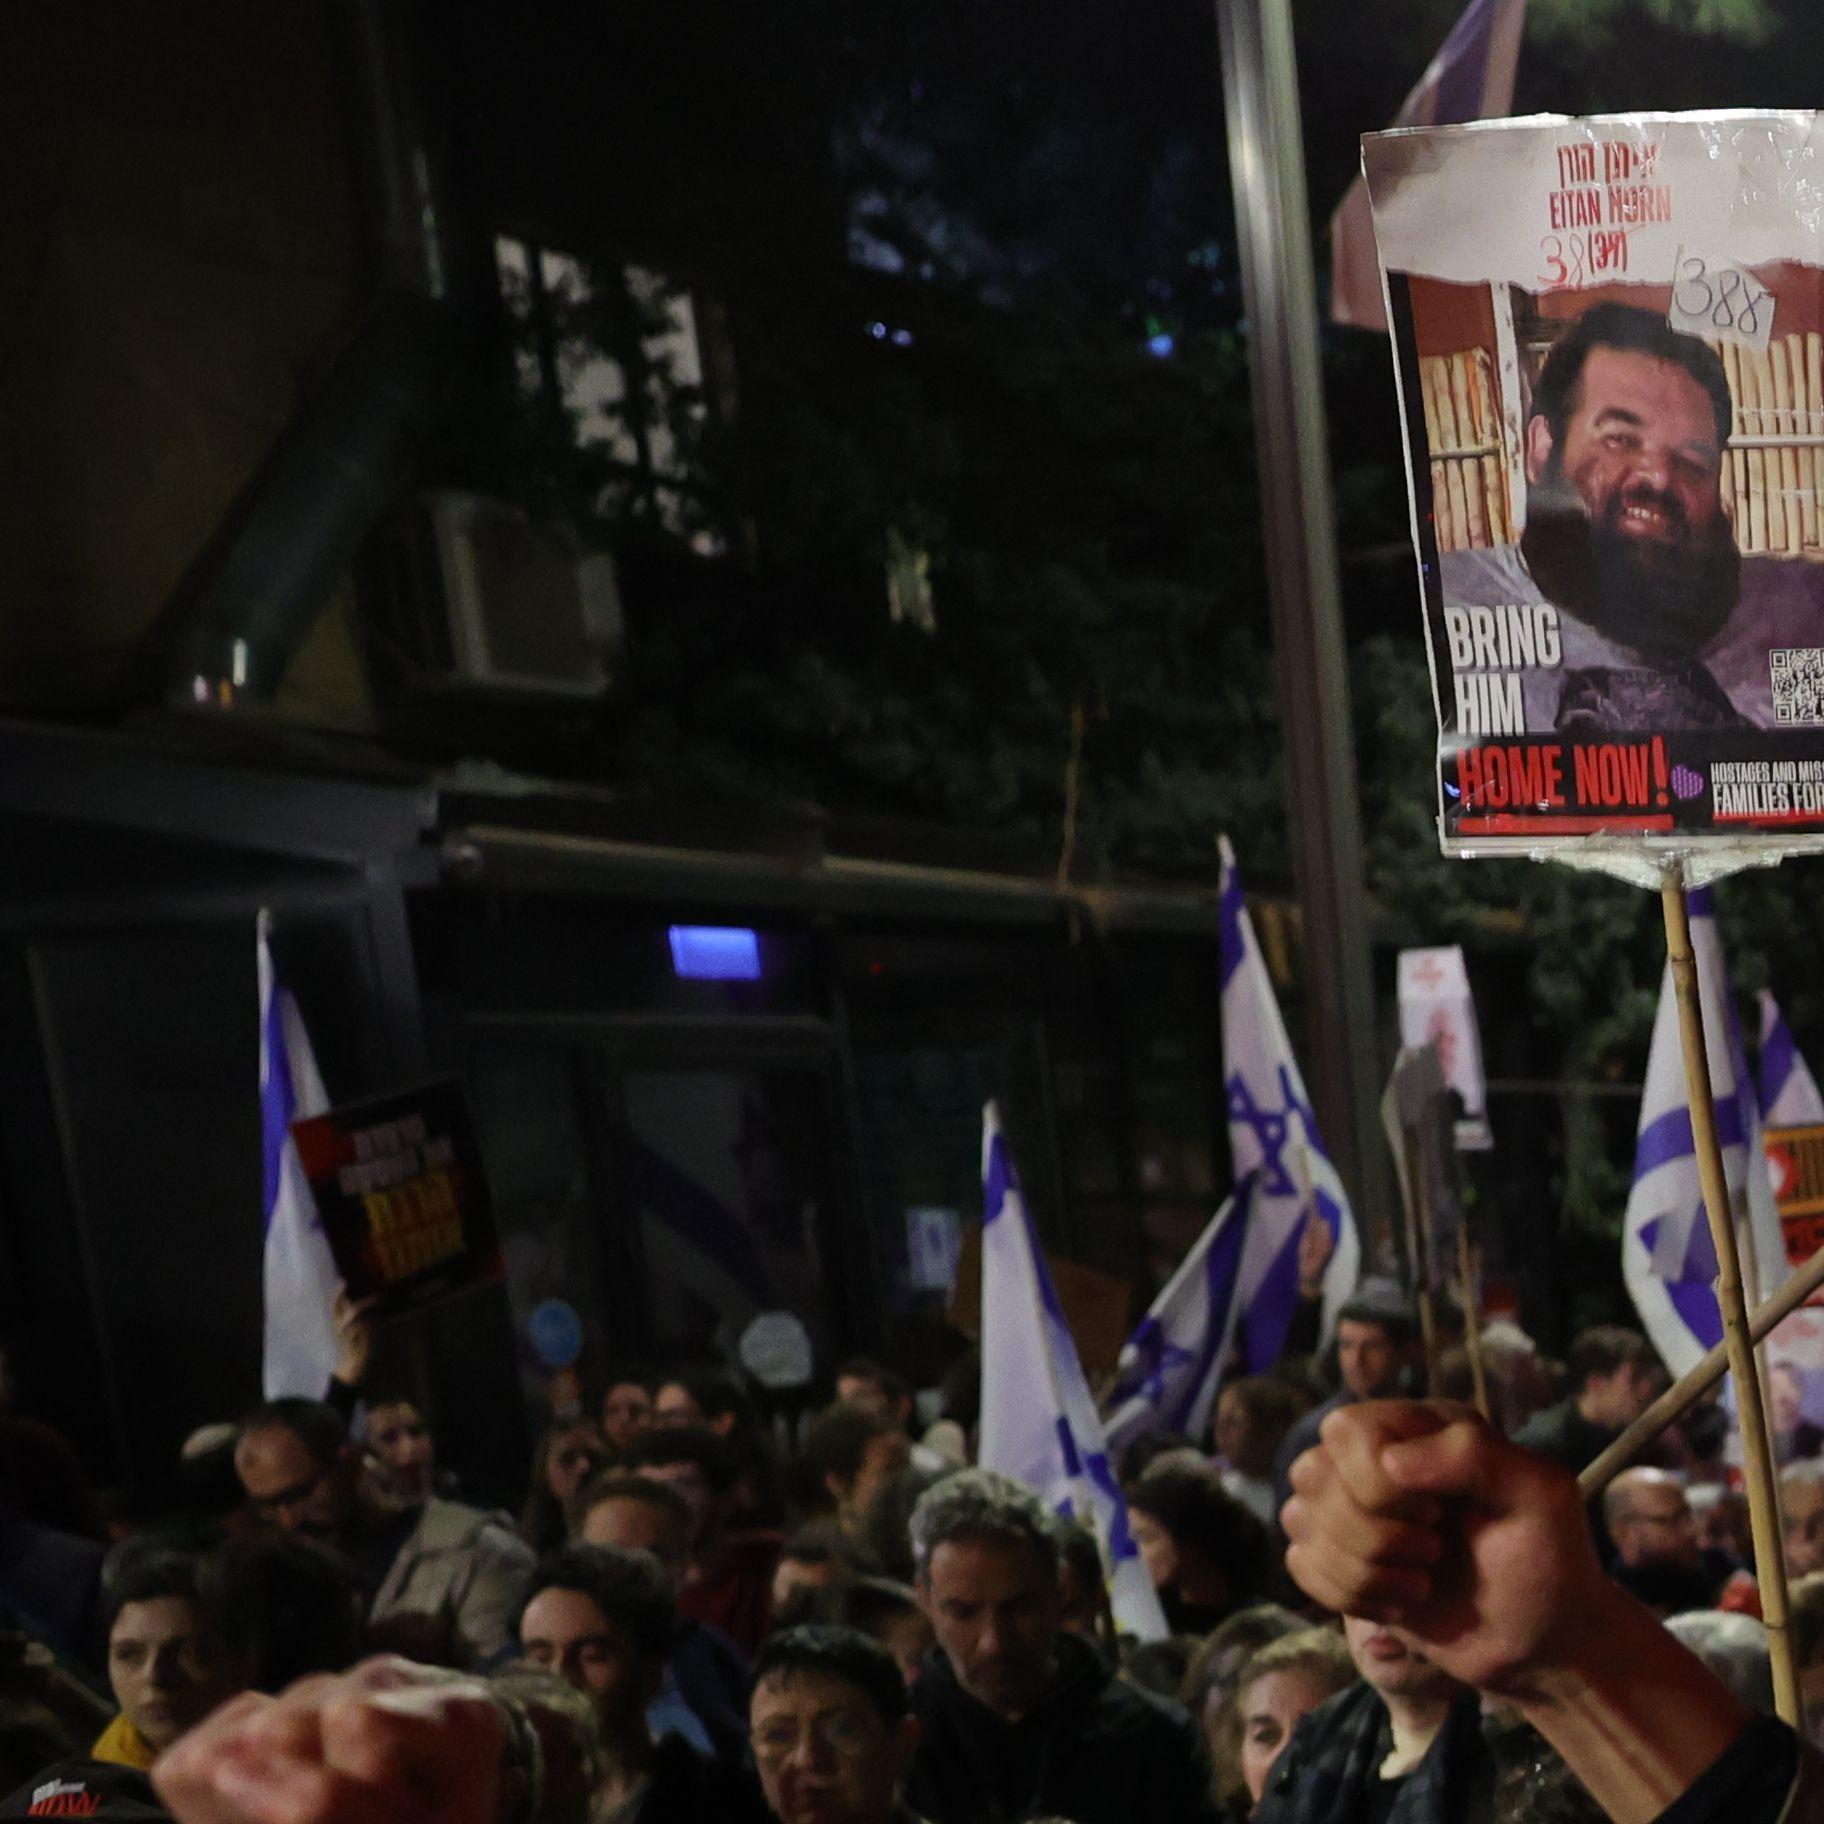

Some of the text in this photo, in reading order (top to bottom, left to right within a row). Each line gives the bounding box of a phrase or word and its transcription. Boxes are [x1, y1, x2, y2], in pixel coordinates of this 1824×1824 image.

[1556, 142, 1596, 189] הורן
[1549, 184, 1672, 230] EITAN HORN
[1444, 603, 1562, 671] BRING
[1454, 672, 1526, 738] HIM
[1457, 735, 1670, 809] HOME NOW!
[1710, 761, 1770, 784] HOSTAGES
[1772, 760, 1797, 783] AND
[1713, 781, 1790, 818] FAMILIES
